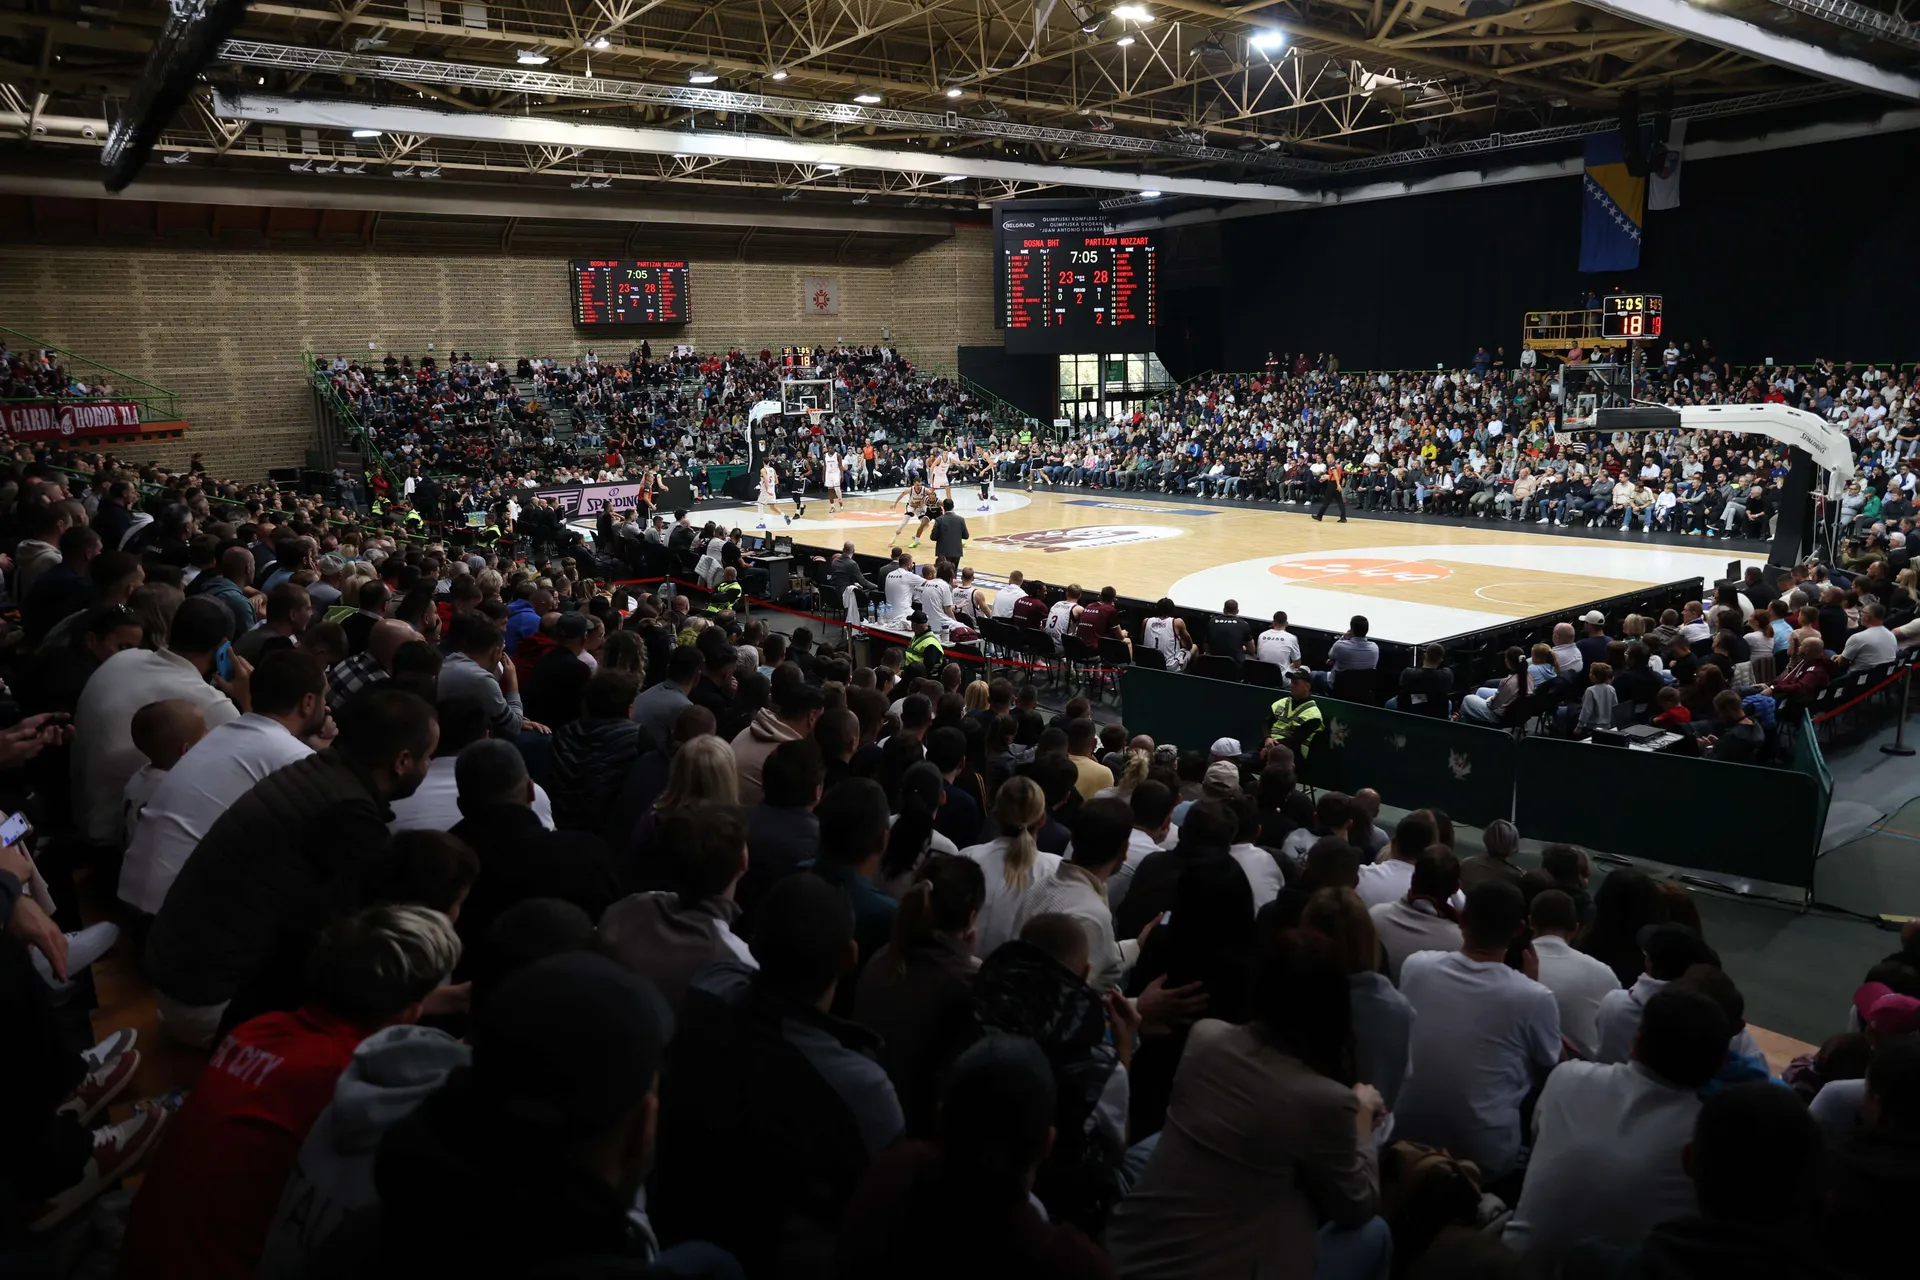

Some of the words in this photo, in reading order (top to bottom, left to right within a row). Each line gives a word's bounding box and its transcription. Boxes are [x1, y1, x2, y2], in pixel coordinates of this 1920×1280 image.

[1121, 237, 1148, 245] MOZZART
[1070, 251, 1098, 263] 7:05
[627, 270, 648, 279] 7:05
[1059, 271, 1073, 284] 23
[1094, 270, 1108, 283] 28
[619, 284, 630, 293] 23
[645, 284, 656, 293] 28
[1076, 293, 1082, 304] 2
[1615, 298, 1642, 310] 7:05
[1058, 314, 1062, 325] 1
[1096, 313, 1102, 324] 2
[1624, 316, 1642, 335] 18
[801, 356, 810, 367] 18
[11, 408, 60, 432] GARDA
[74, 406, 118, 428] HORDE
[119, 405, 140, 424] ZLA
[1800, 432, 1827, 454] SPALDING
[1049, 616, 1058, 628] 3
[1154, 637, 1158, 648] 1
[228, 1046, 284, 1085] CITY
